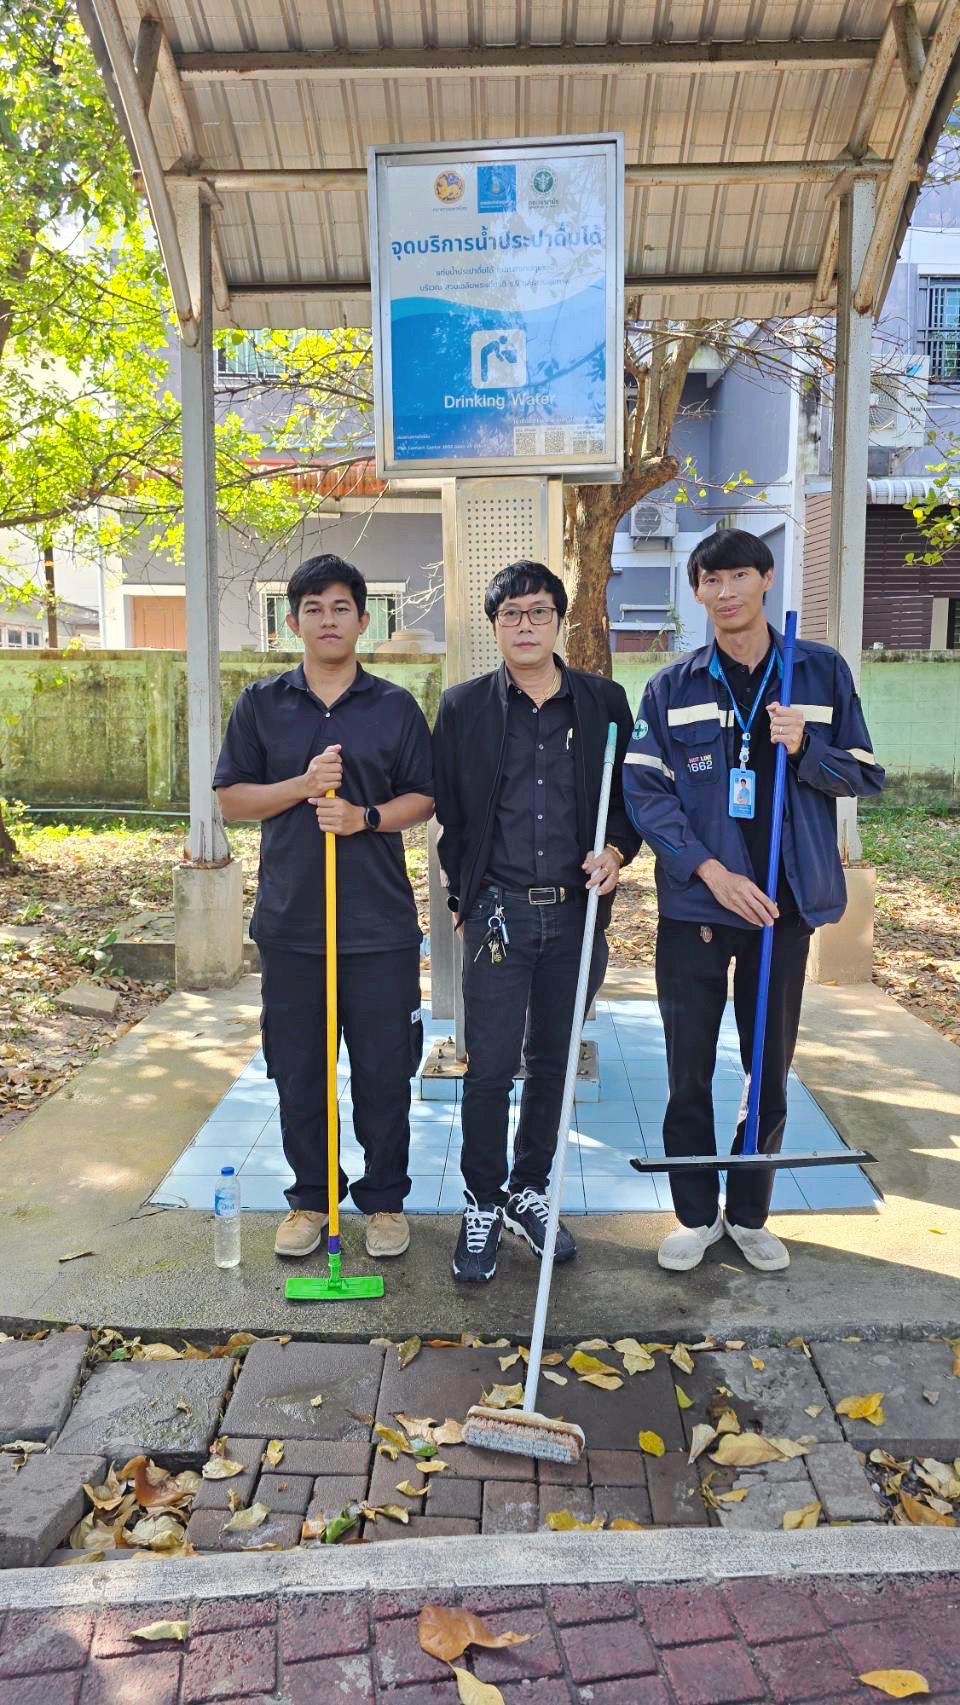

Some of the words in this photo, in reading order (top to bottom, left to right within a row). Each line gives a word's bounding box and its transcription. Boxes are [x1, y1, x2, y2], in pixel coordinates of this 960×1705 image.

[391, 225, 602, 260] จุดบริการน้ำประปาดื่มได้
[444, 394, 505, 409] Drinking
[512, 393, 556, 405] Water
[700, 754, 712, 762] LINE
[688, 760, 713, 773] 1662
